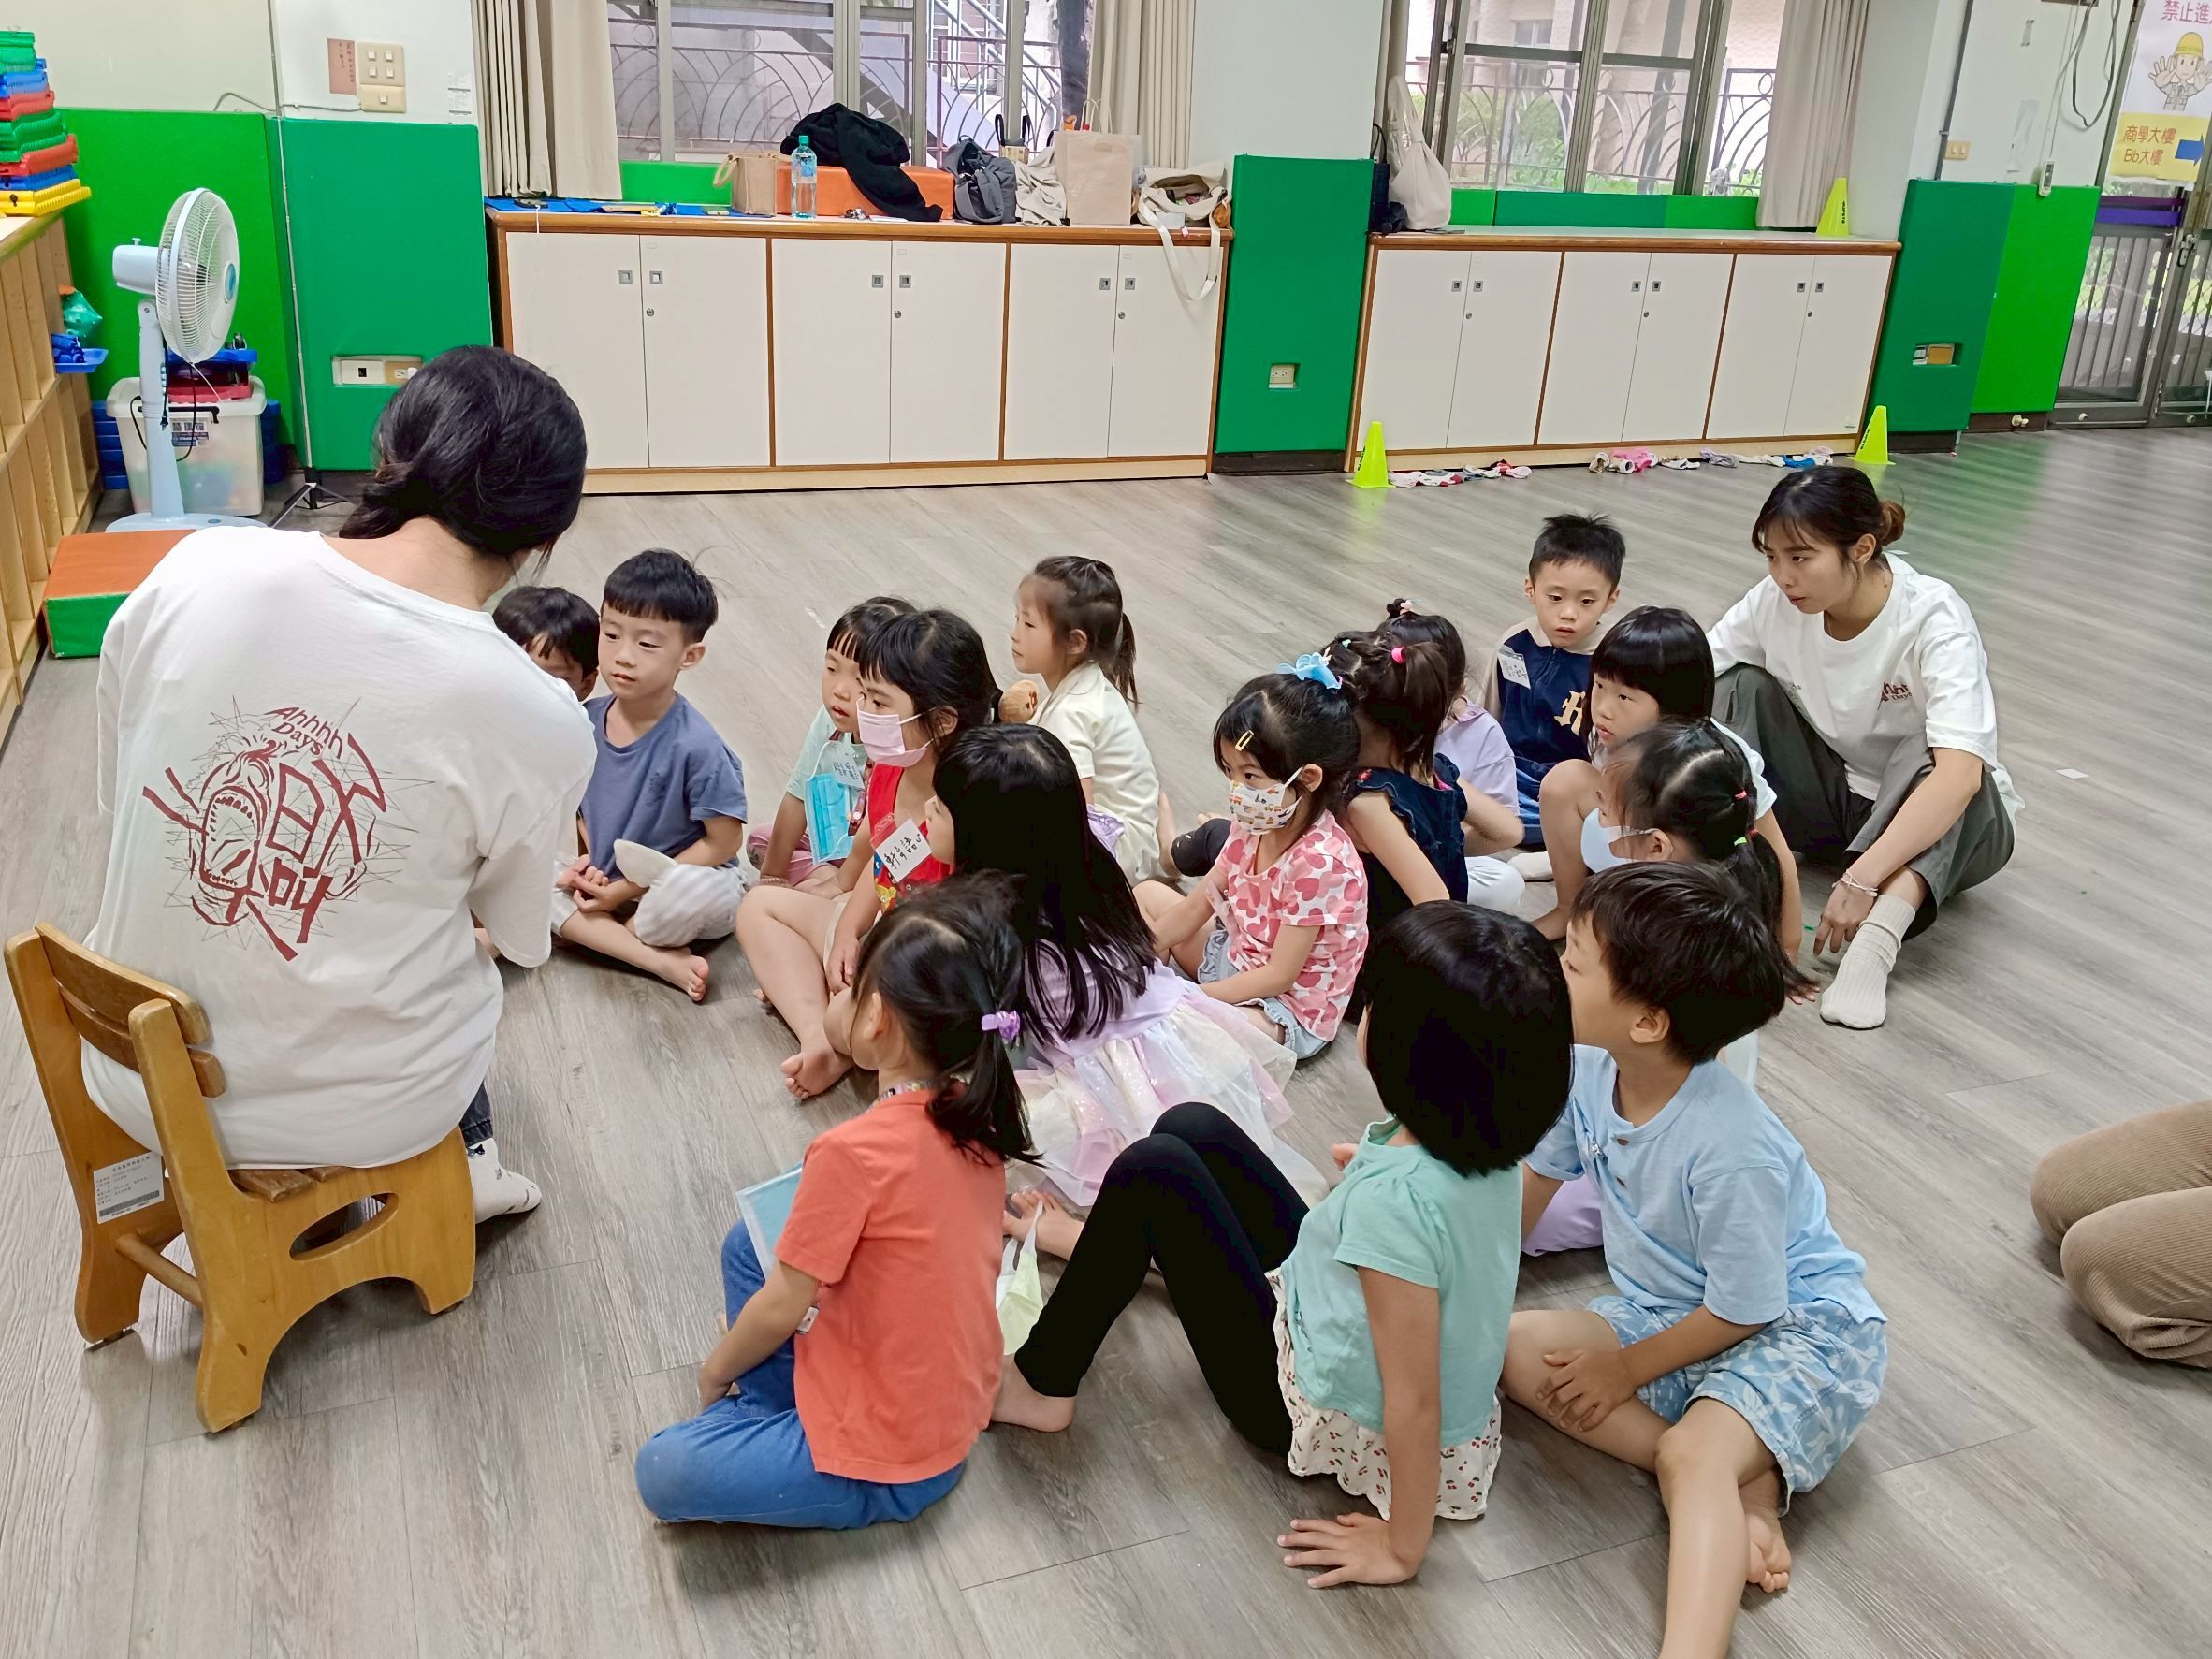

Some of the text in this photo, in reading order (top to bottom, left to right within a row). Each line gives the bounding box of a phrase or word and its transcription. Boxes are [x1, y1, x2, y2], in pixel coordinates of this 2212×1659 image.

[2161, 0, 2212, 24] 禁止進
[2123, 125, 2177, 144] 商學大樓
[264, 706, 343, 759] Ahhhh
[271, 721, 324, 755] Days
